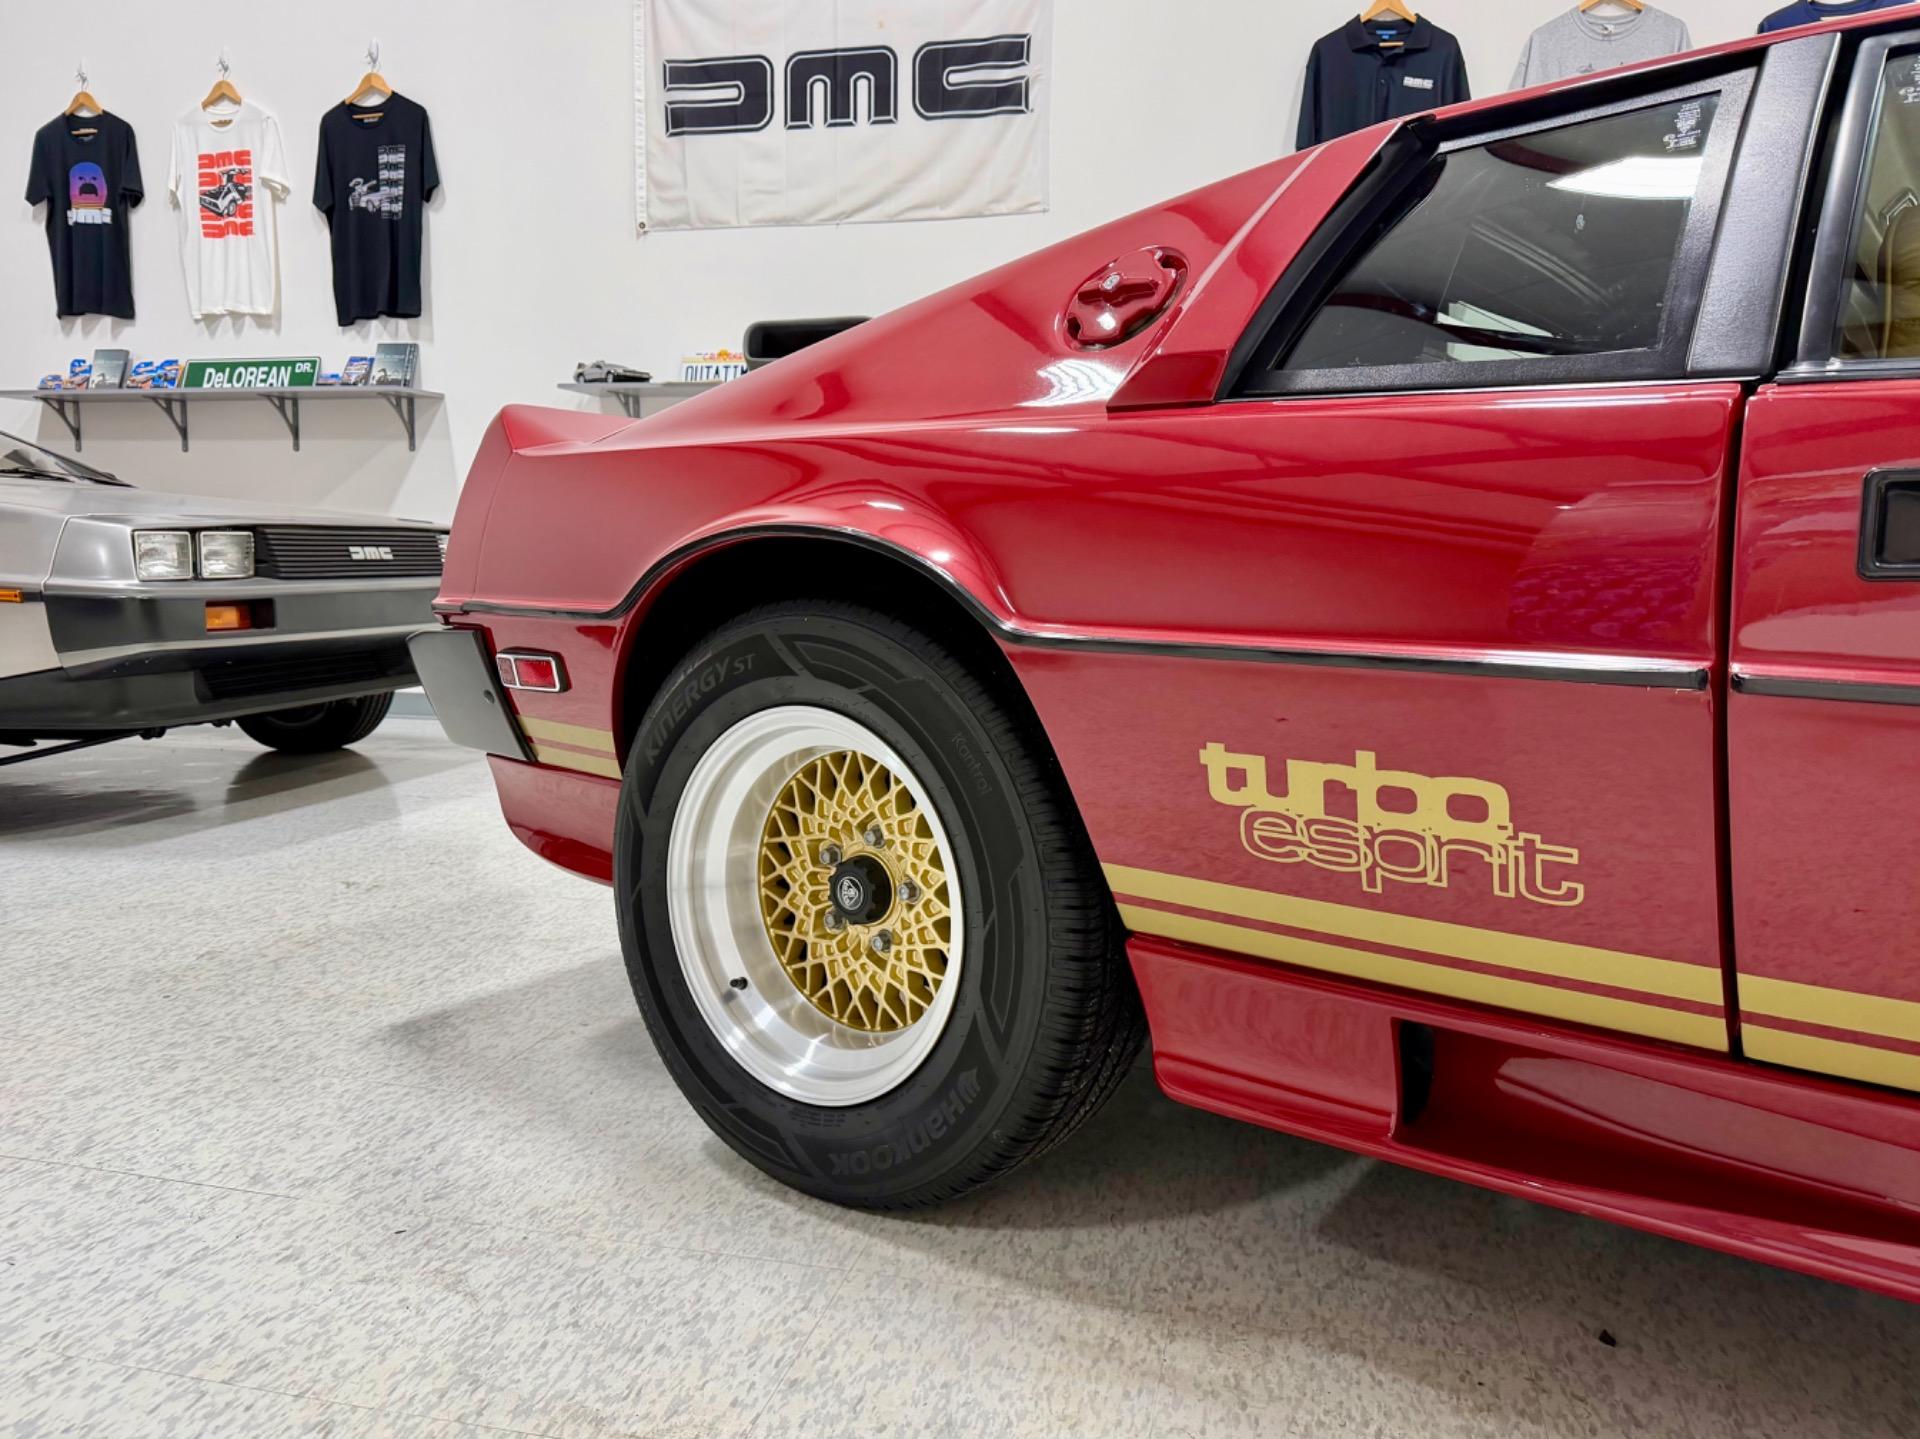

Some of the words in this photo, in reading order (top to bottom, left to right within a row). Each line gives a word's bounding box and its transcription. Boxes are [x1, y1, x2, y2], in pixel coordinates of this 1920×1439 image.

[663, 33, 1032, 137] DMC
[202, 366, 292, 388] DeLOREAN
[295, 362, 313, 373] DR.
[349, 546, 393, 560] DMC
[1199, 742, 1511, 838] turbo
[1240, 806, 1584, 907] esprit
